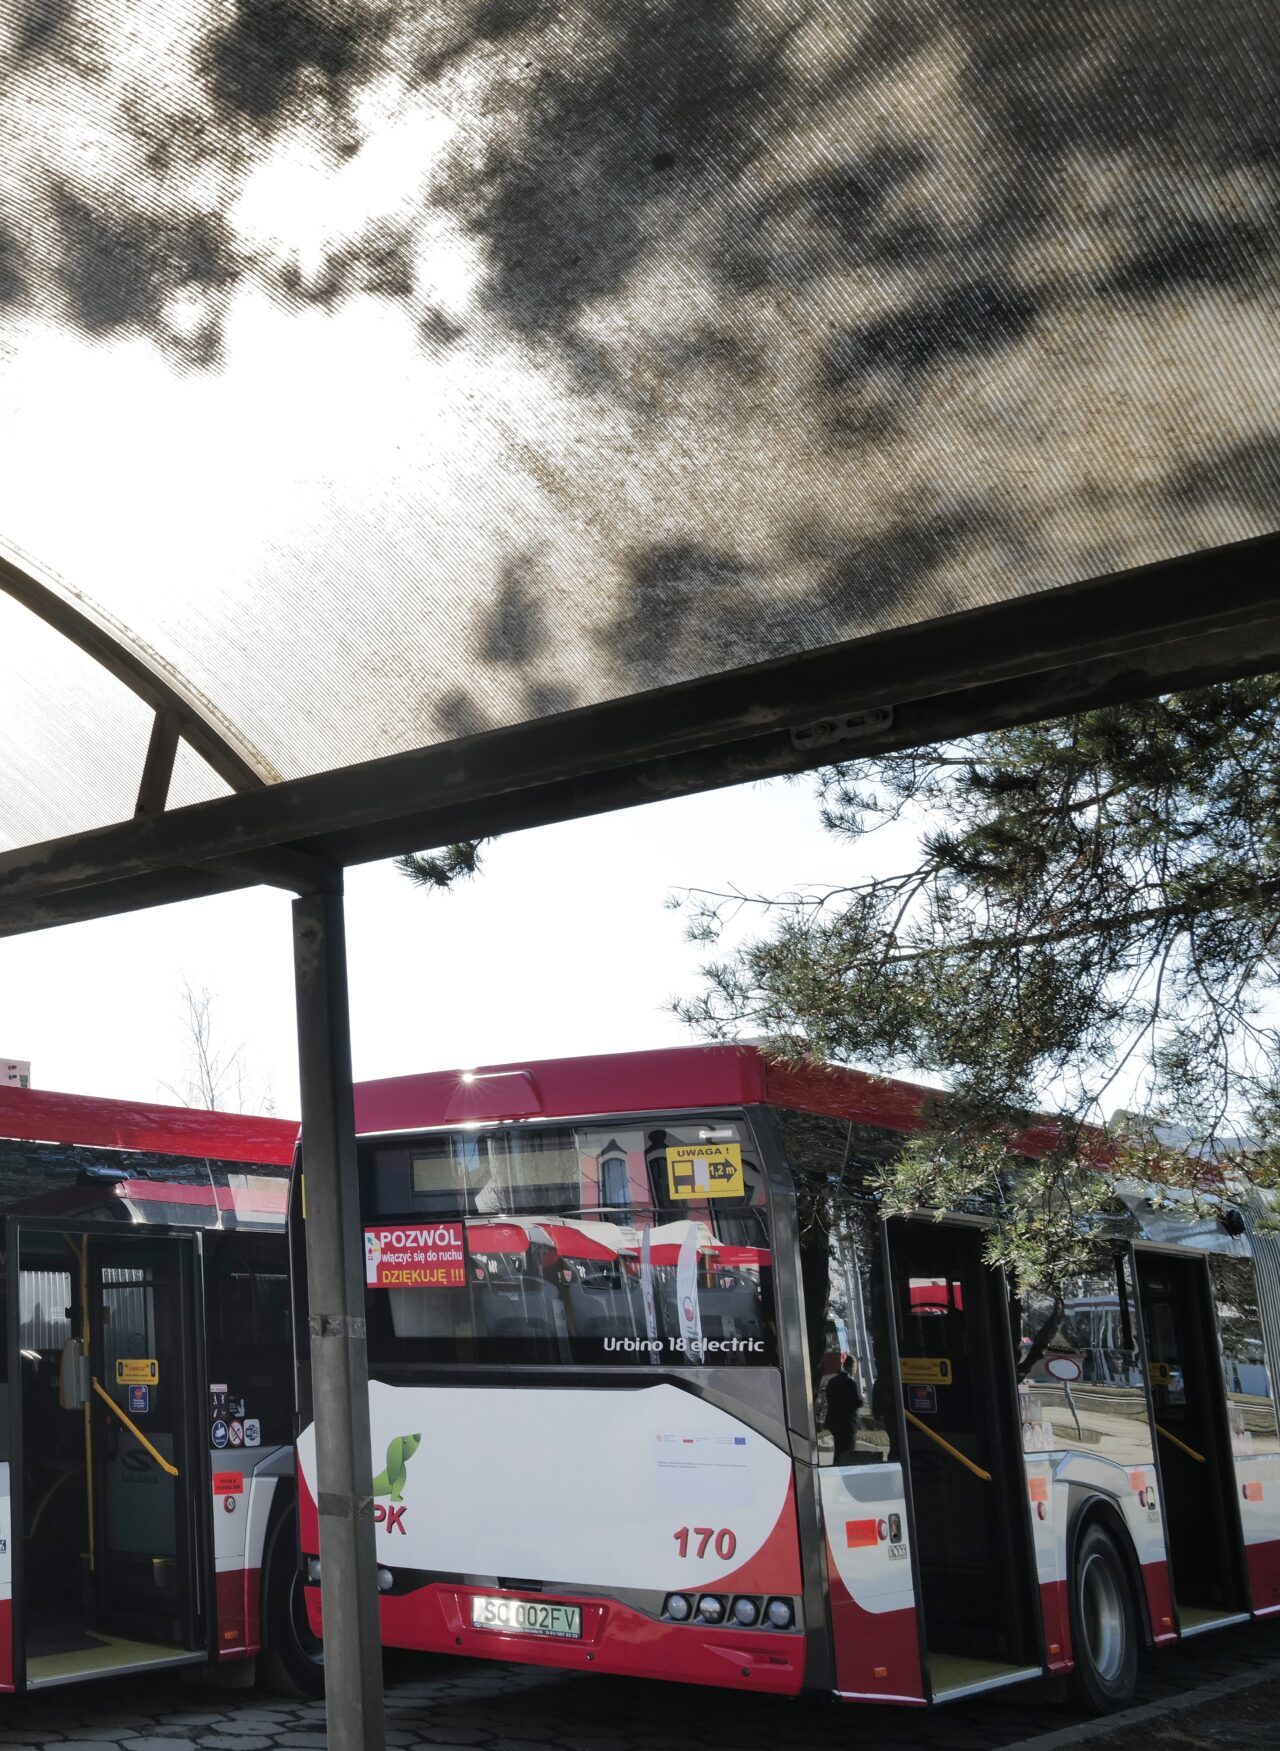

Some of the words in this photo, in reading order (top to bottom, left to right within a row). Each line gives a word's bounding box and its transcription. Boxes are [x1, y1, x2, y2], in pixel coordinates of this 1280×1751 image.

[677, 1148, 722, 1157] UWAGA
[709, 1165, 724, 1177] 1,2
[725, 1167, 735, 1175] m
[380, 1225, 462, 1248] POZWÓL
[381, 1250, 412, 1265] włączyć
[413, 1250, 425, 1264] się
[426, 1250, 438, 1261] do
[439, 1249, 463, 1260] ruchu
[382, 1268, 447, 1285] DZIĘKUJĘ
[451, 1268, 464, 1281] !!!
[603, 1337, 663, 1351] Urbino
[668, 1337, 687, 1351] 18
[690, 1337, 764, 1352] electric
[373, 1503, 408, 1535] PK
[673, 1526, 737, 1561] 170
[484, 1600, 511, 1625] SC
[515, 1604, 575, 1631] 002FV
